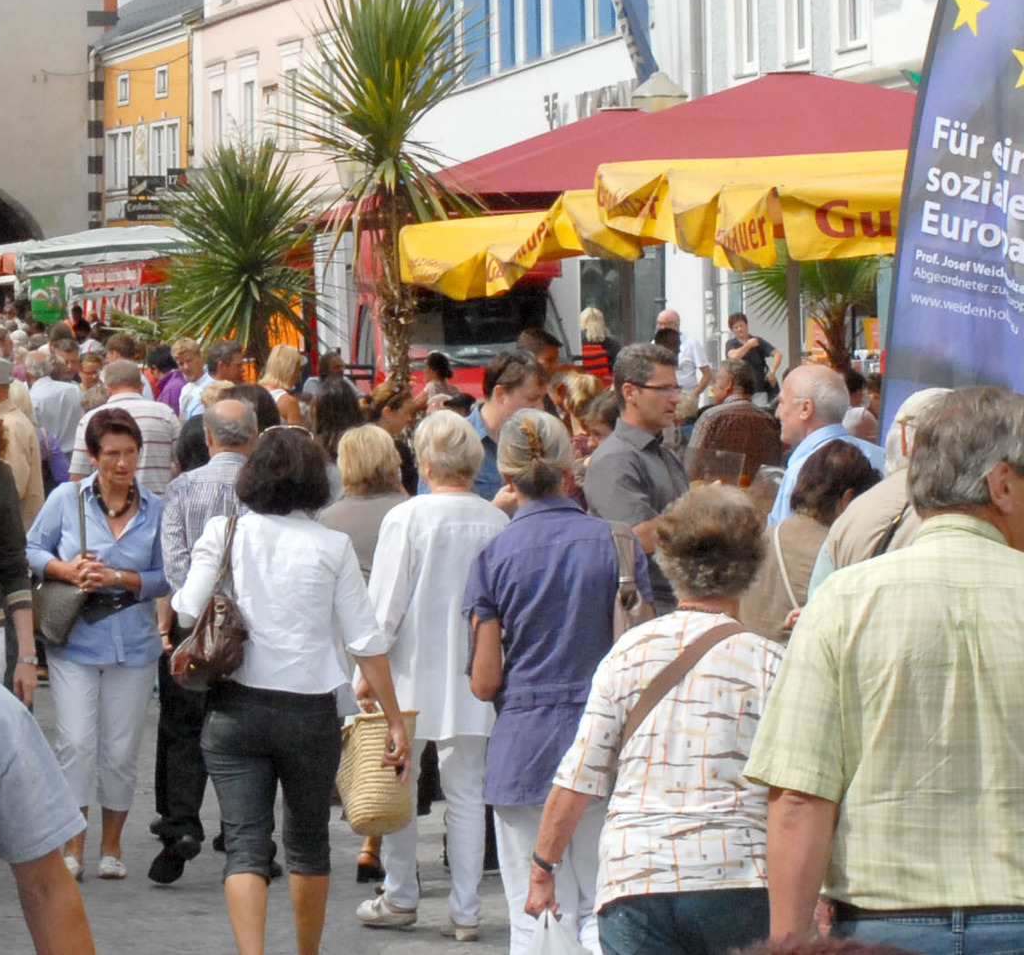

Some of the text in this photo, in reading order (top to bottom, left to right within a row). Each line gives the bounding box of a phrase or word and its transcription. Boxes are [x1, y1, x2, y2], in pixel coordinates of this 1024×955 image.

[932, 116, 985, 159] Für
[916, 249, 940, 265] Prof.
[941, 256, 971, 272] Josef
[913, 267, 1010, 296] Abgeordneter zu
